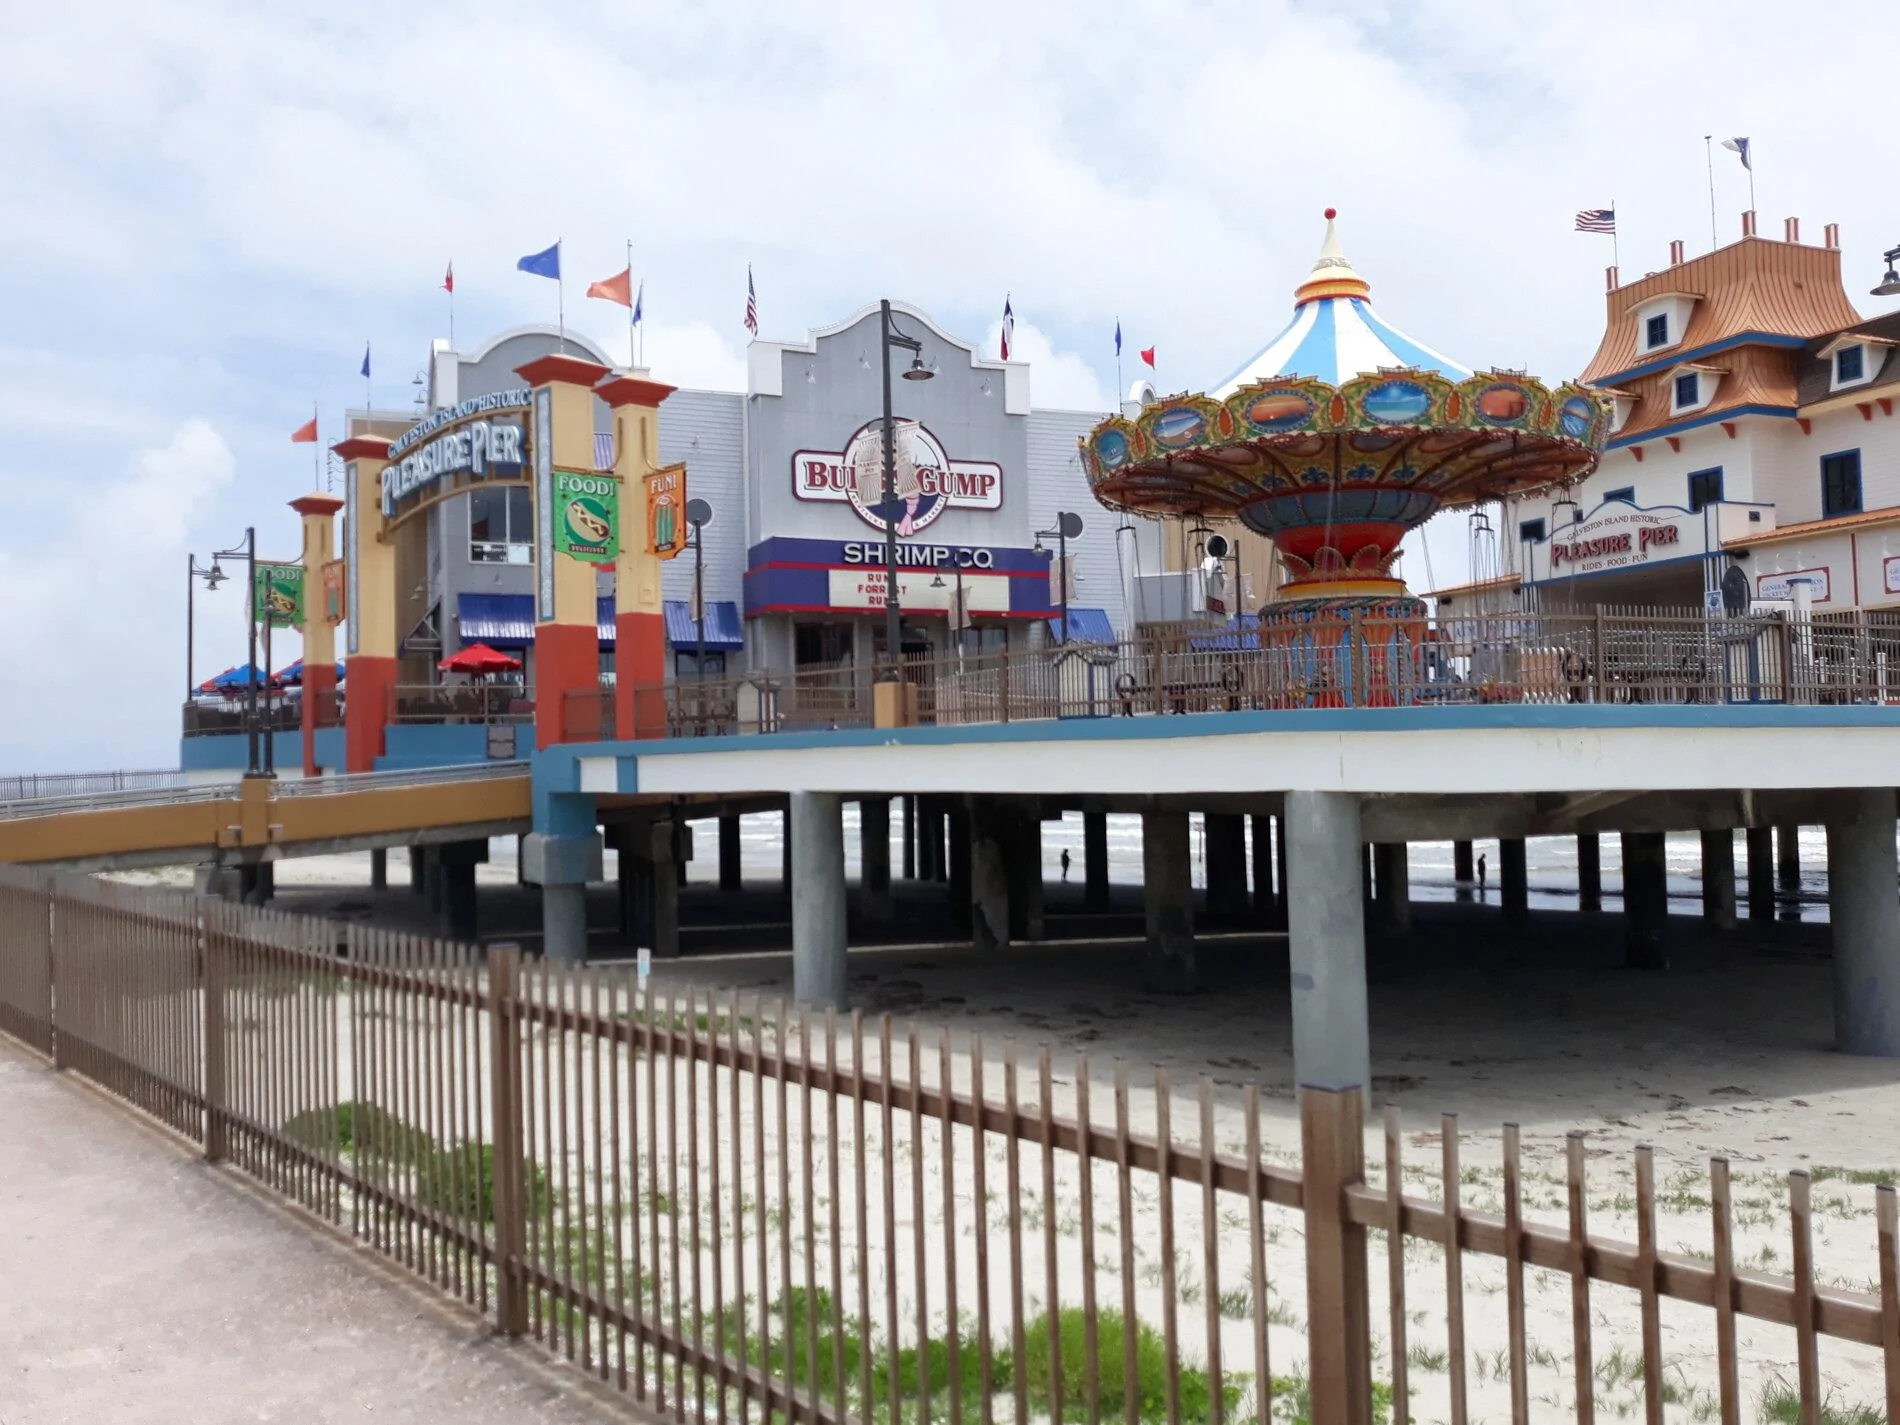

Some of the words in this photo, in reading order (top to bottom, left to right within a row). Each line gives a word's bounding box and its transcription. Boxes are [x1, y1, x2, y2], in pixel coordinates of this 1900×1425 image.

[479, 388, 532, 411] HISTORIC
[381, 430, 473, 517] PLEASURE
[472, 421, 525, 475] PIER
[559, 475, 615, 496] FOOD!
[651, 474, 677, 494] FUN!
[914, 466, 995, 497] GUMP
[1567, 520, 1604, 541] GALVESTON
[1604, 514, 1629, 527] ISLAND
[1630, 514, 1661, 525] HISTORIC
[844, 543, 949, 566] SHRIMP
[1551, 533, 1632, 567] PLEASURE
[1639, 525, 1679, 551] PIER
[1582, 562, 1603, 571] RIDES
[1607, 557, 1628, 567] FOOD
[1632, 552, 1648, 563] FUN
[858, 584, 907, 595] FORRST
